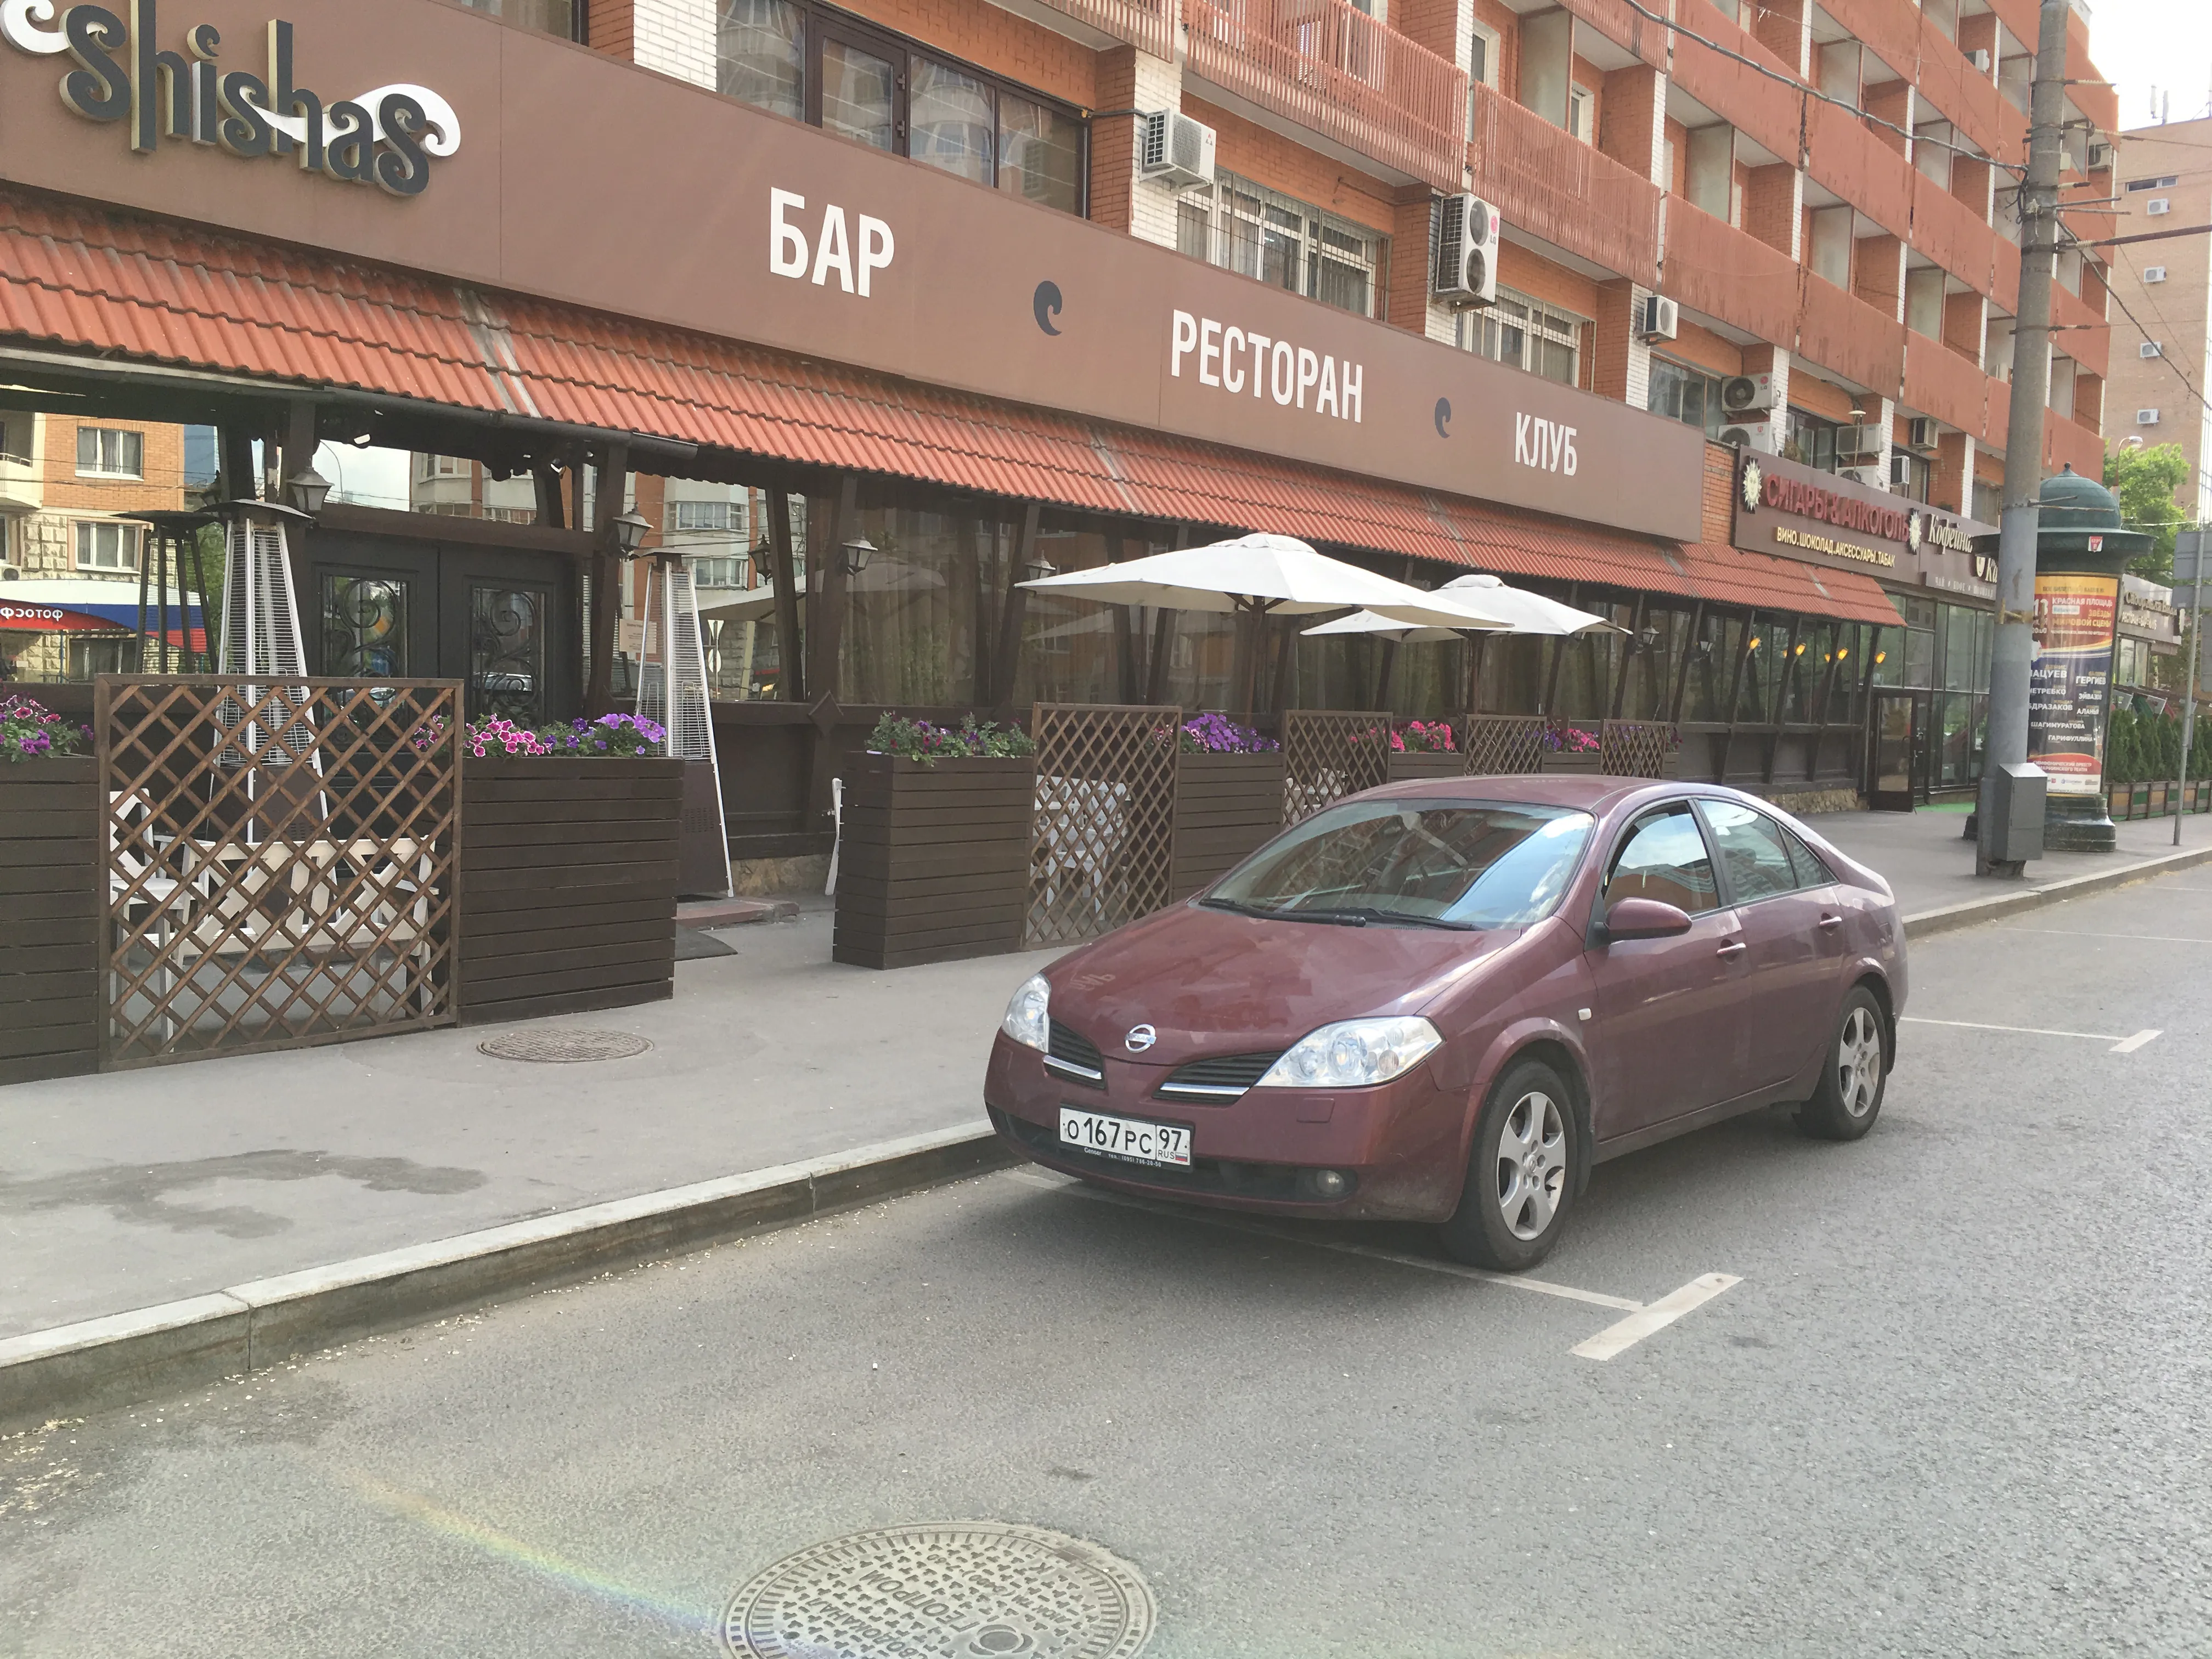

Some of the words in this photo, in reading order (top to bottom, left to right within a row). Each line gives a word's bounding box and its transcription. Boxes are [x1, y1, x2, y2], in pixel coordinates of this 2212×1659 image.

[770, 187, 895, 298] БАР
[1171, 309, 1363, 423] РЕСТОРАН
[1515, 411, 1577, 476] КЛУБ
[1766, 473, 1829, 520] СИГАРЫ
[1839, 496, 1910, 542] АЛКОГОЛЬ
[2052, 597, 2085, 605] КРАСНАЯ
[2052, 617, 2091, 627] МИРОВОЙ
[2075, 675, 2107, 685] ГЕРГИЕВ
[2028, 703, 2073, 711] БДРАЗАКОВ
[1158, 1150, 1175, 1159] RUS
[859, 1570, 980, 1633] ГЕОПРОМ
